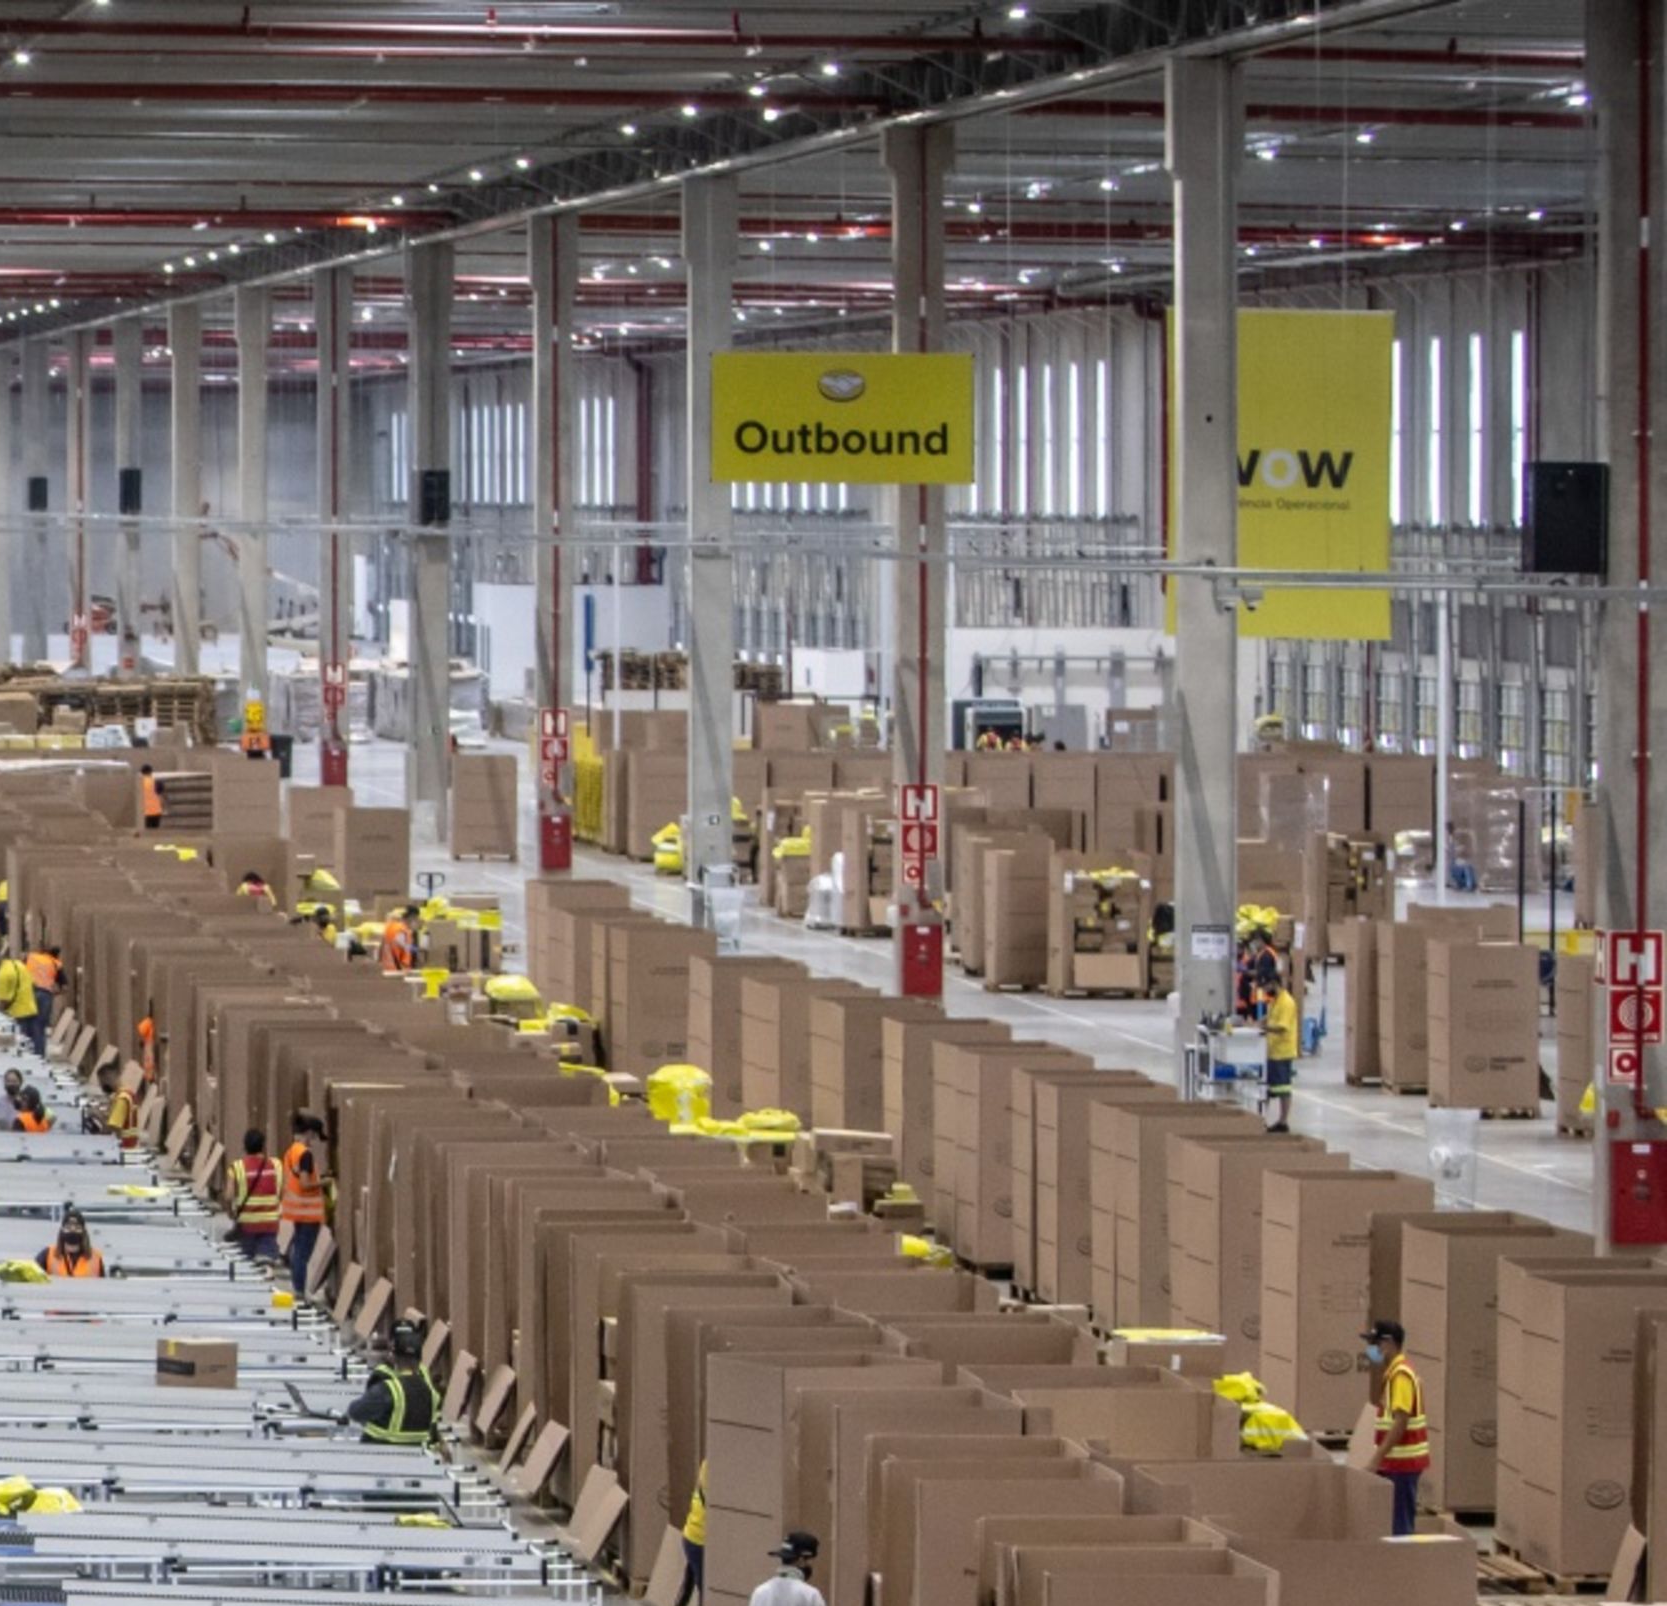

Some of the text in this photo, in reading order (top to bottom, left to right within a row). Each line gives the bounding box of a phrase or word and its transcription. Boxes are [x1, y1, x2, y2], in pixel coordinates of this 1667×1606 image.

[734, 420, 948, 455] Outbound
[1276, 498, 1350, 511] Operacional
[907, 789, 934, 818] H
[1617, 938, 1656, 981] H
